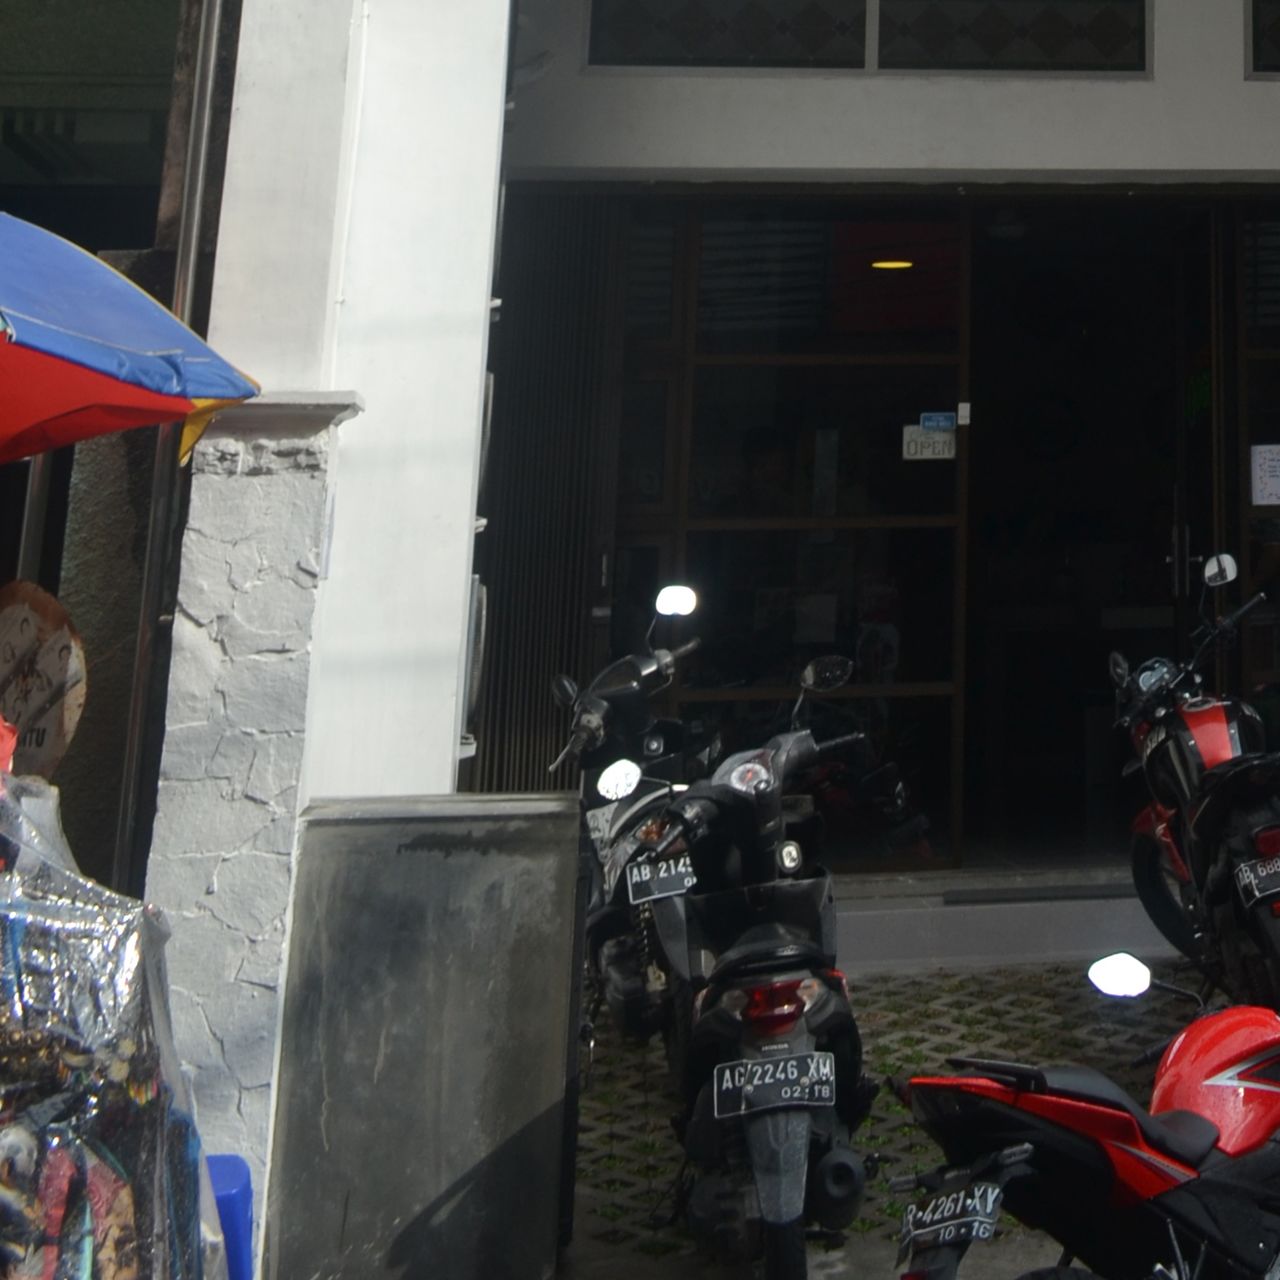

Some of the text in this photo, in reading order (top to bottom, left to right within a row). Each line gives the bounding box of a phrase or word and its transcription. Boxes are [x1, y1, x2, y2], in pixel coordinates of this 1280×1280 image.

[907, 439, 952, 457] OPEN
[632, 864, 651, 884] AB
[722, 1058, 831, 1090] AG 2246 XM
[923, 1190, 965, 1224] 4261
